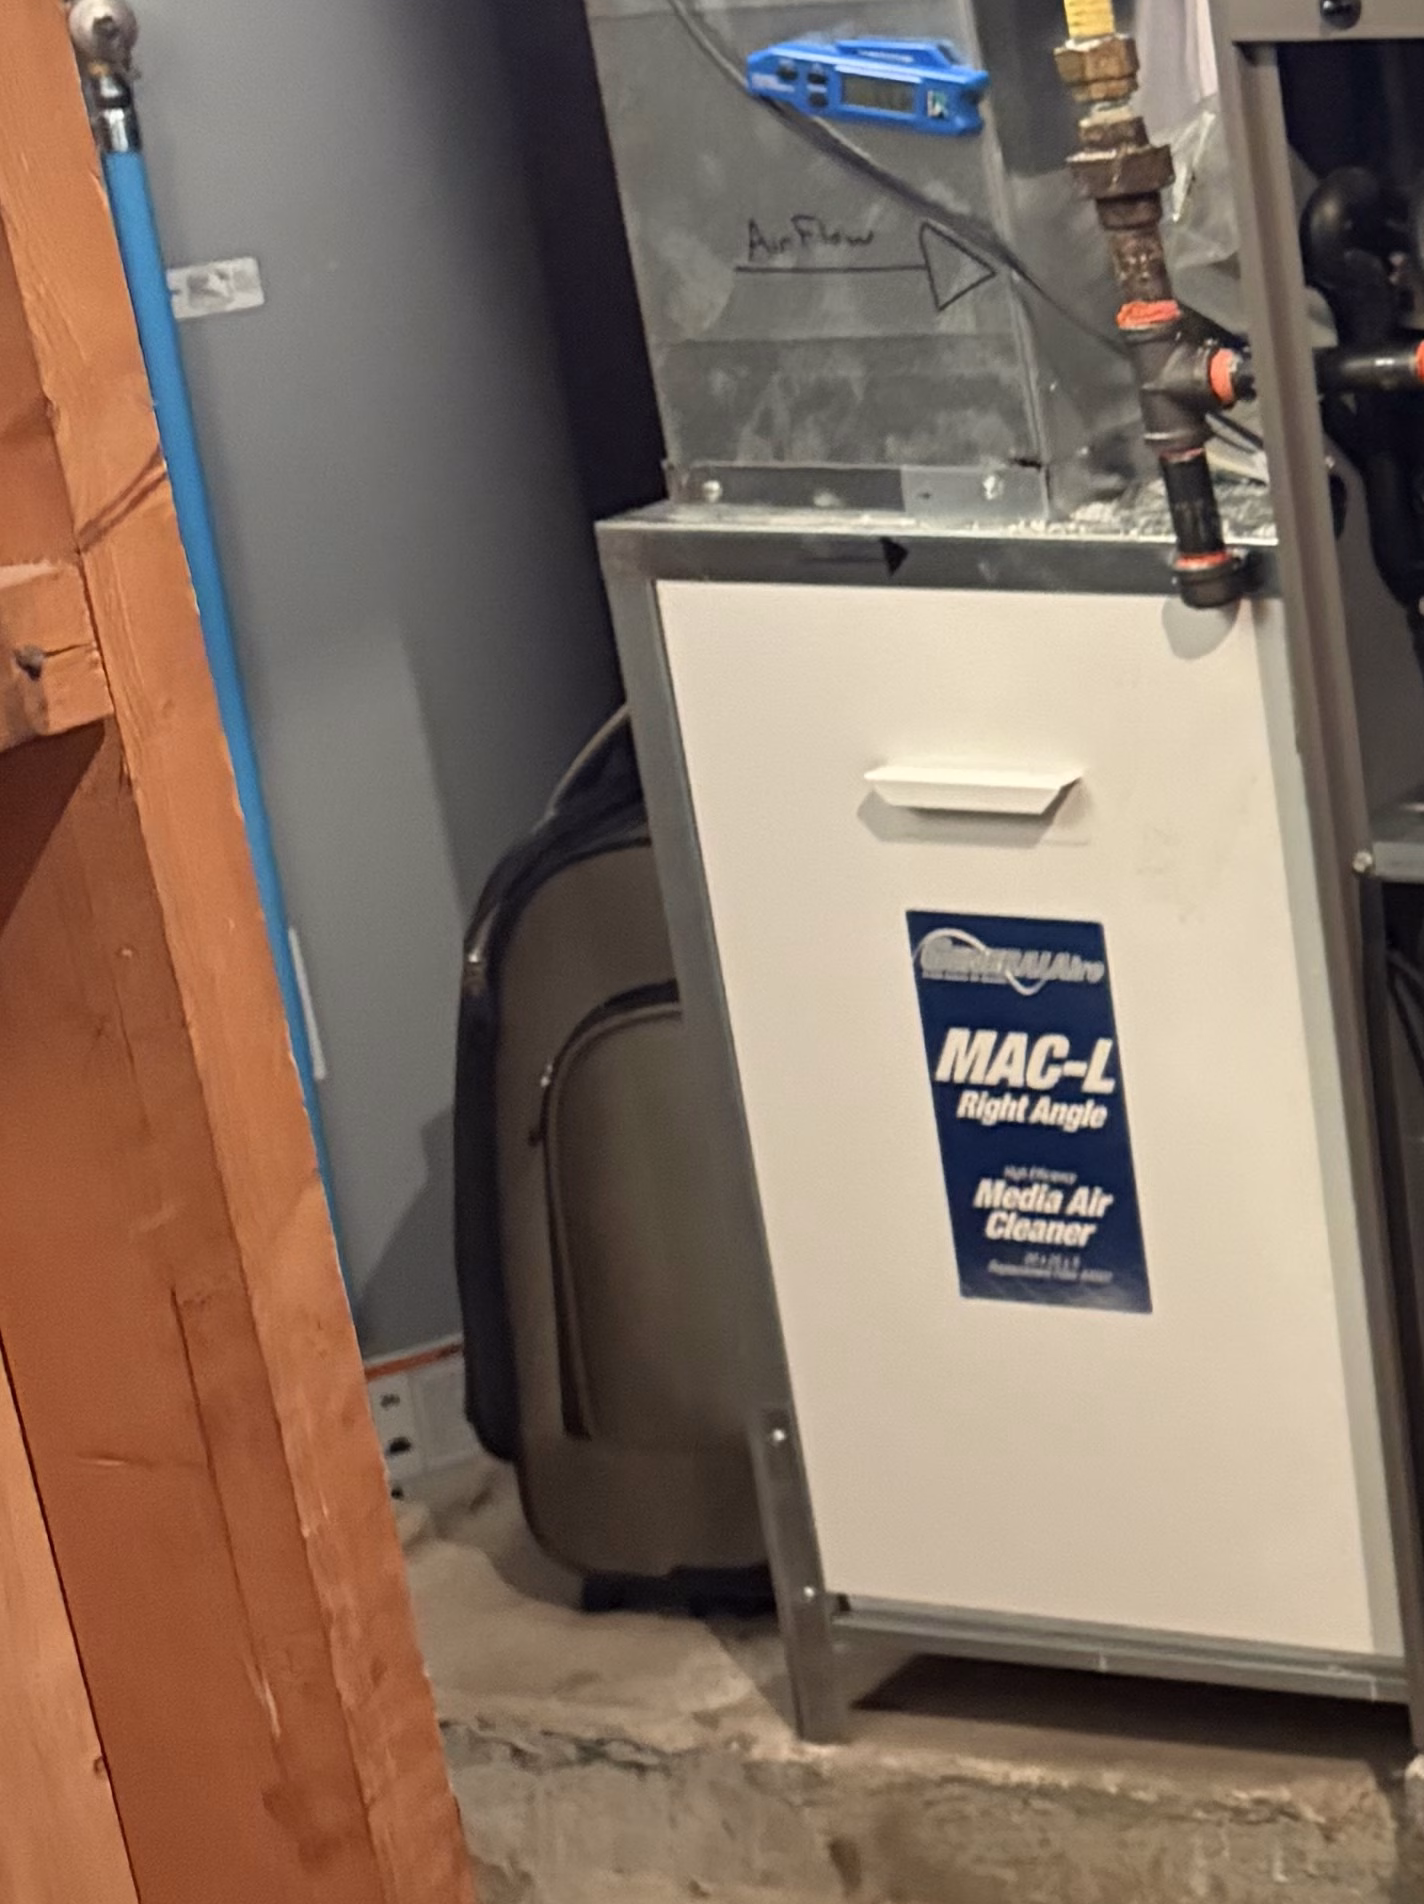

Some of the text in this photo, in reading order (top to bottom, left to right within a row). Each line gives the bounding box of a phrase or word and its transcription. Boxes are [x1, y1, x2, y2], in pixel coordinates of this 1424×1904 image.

[934, 1027, 1116, 1095] MAC-L
[956, 1089, 1108, 1133] Right Angle
[973, 1177, 1114, 1219] Media Air
[984, 1210, 1098, 1248] Cleaner
